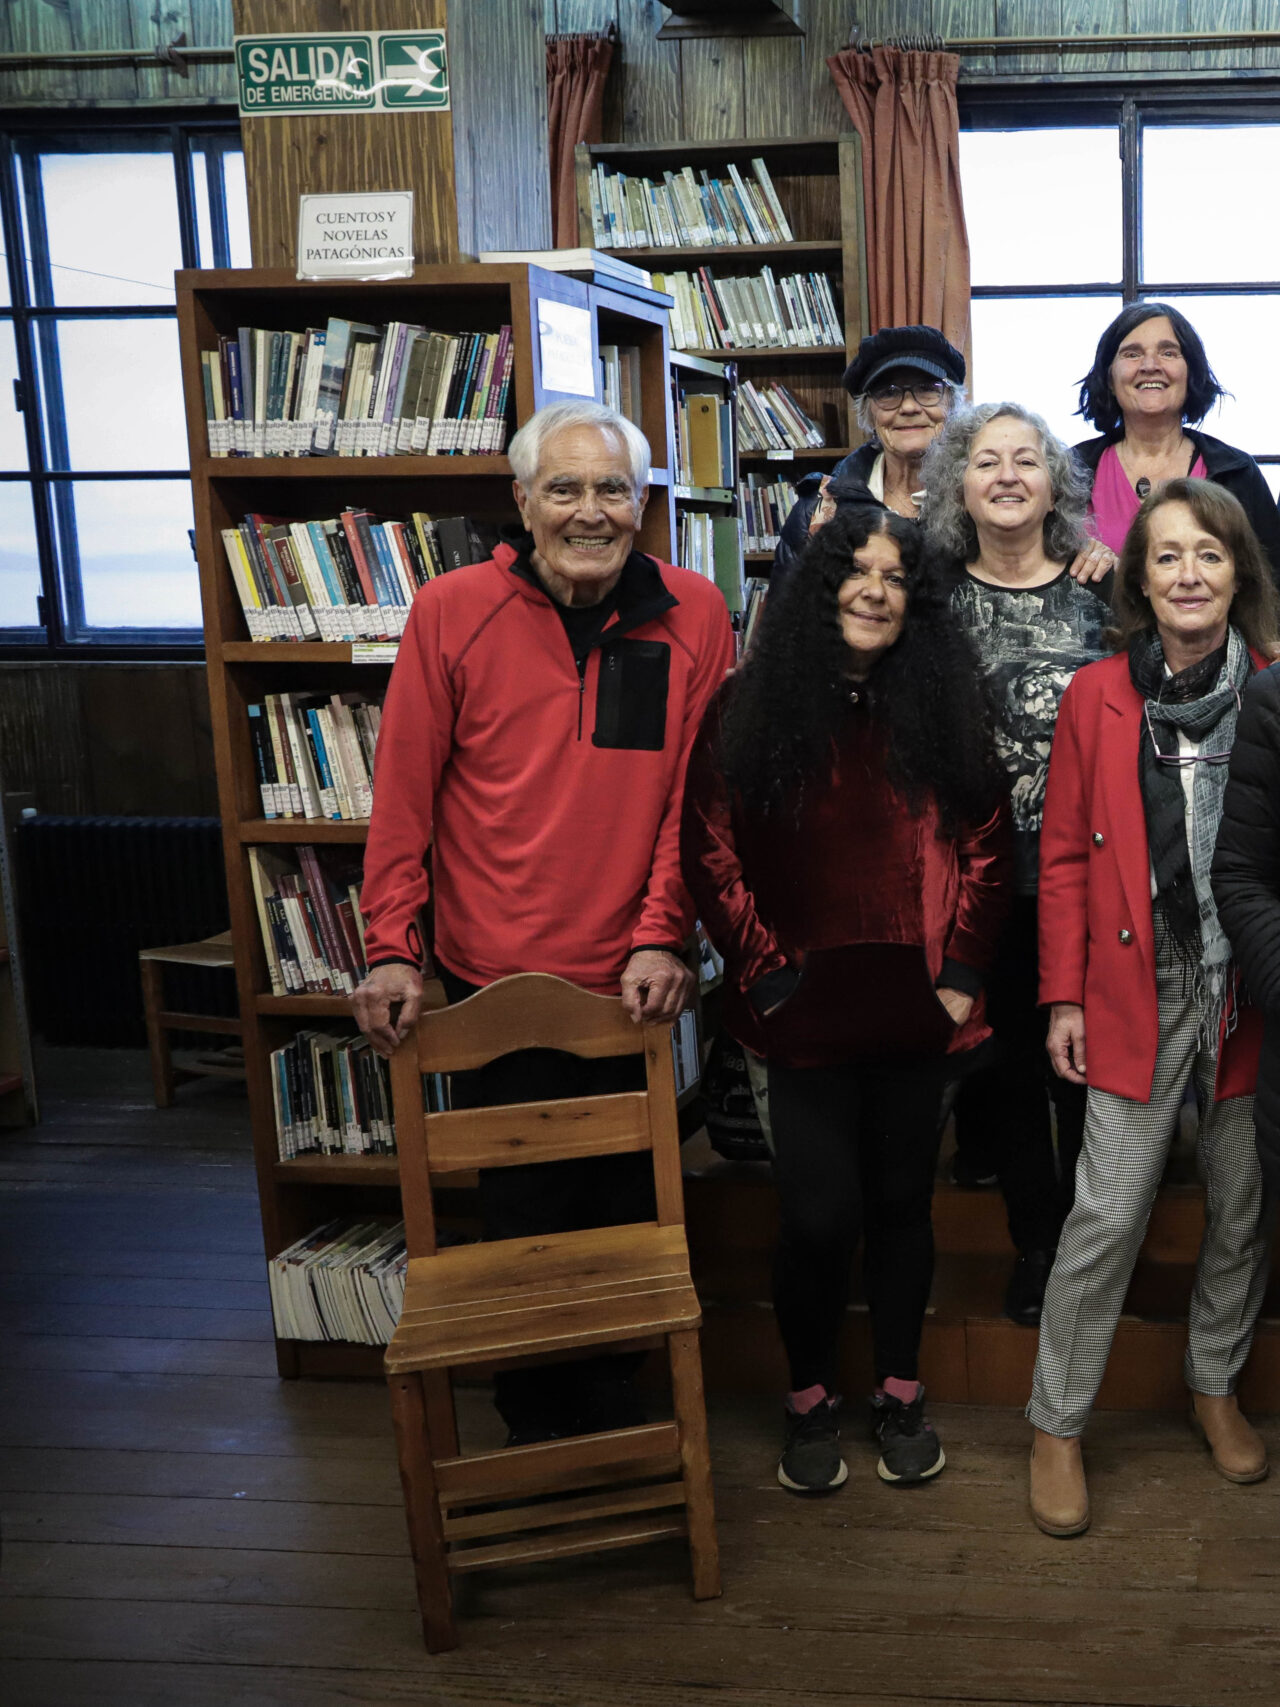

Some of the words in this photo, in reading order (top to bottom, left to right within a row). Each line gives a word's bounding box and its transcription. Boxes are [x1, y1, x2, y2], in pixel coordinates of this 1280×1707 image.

[248, 45, 363, 84] SALIDA
[246, 87, 266, 104] DE
[271, 83, 368, 103] EMERGENCIA
[316, 211, 385, 225] CUENTOS
[387, 211, 396, 222] Y
[323, 228, 388, 242] NOVELAS
[306, 244, 405, 260] PATAGÓNICAS
